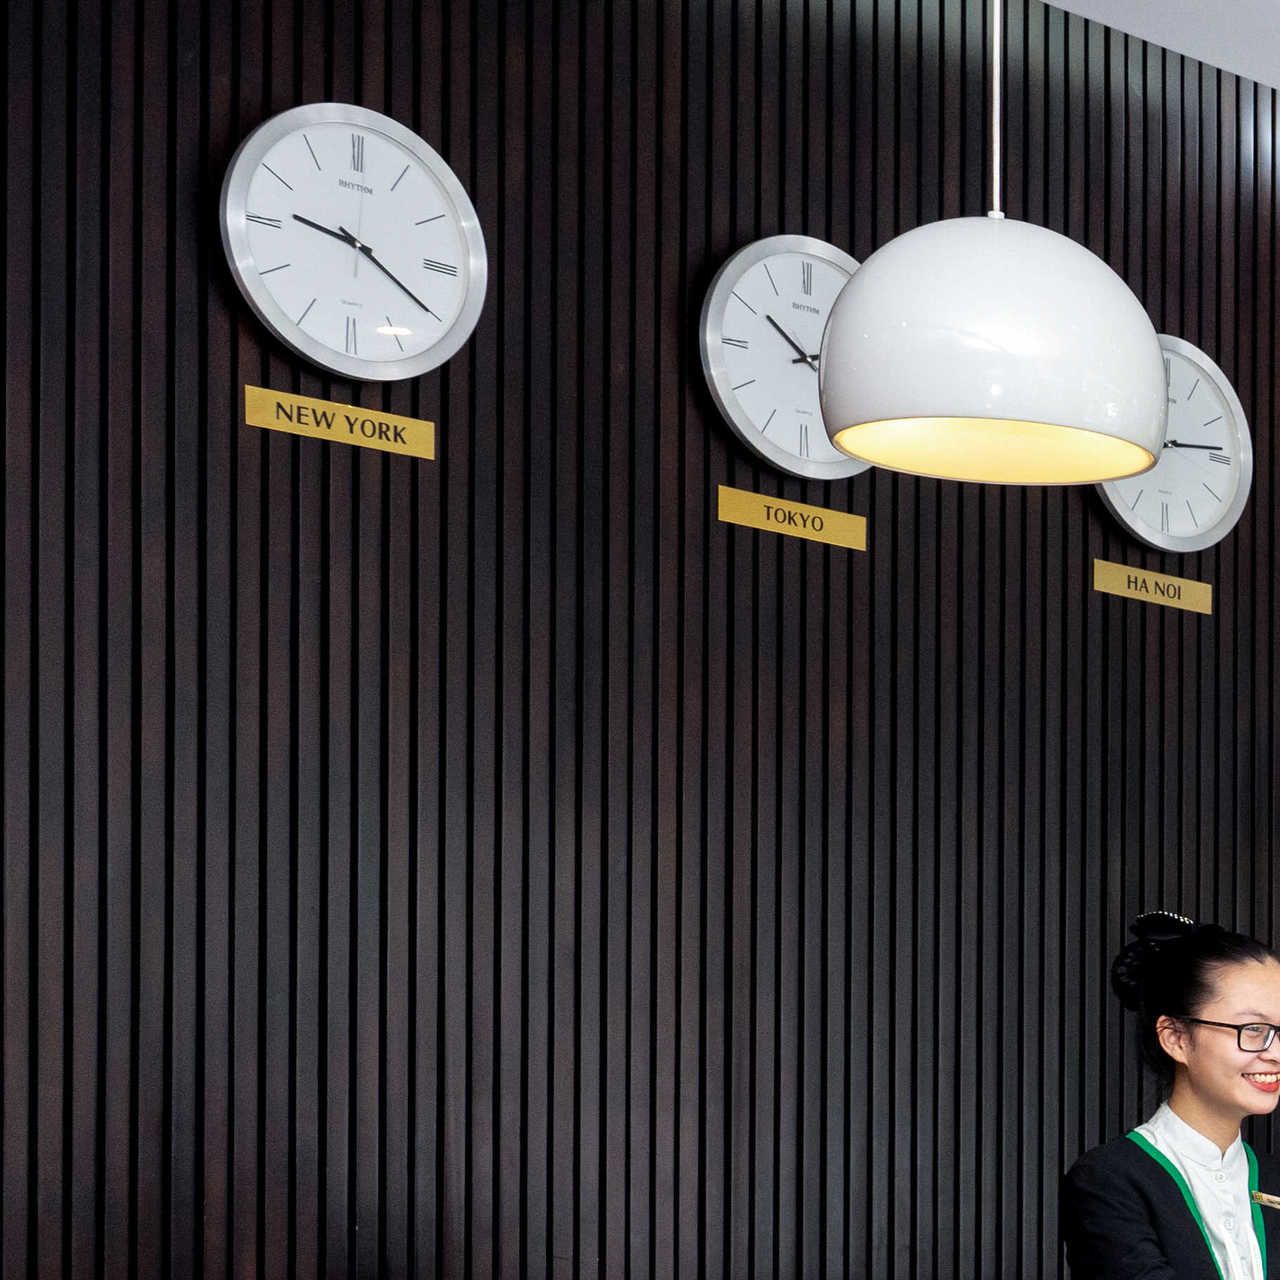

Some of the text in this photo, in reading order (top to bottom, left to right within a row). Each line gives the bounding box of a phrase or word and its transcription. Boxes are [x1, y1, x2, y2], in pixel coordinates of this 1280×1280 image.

[275, 401, 408, 445] NEW YORK
[763, 504, 825, 532] TOKYO
[1127, 574, 1182, 601] HA NOI
